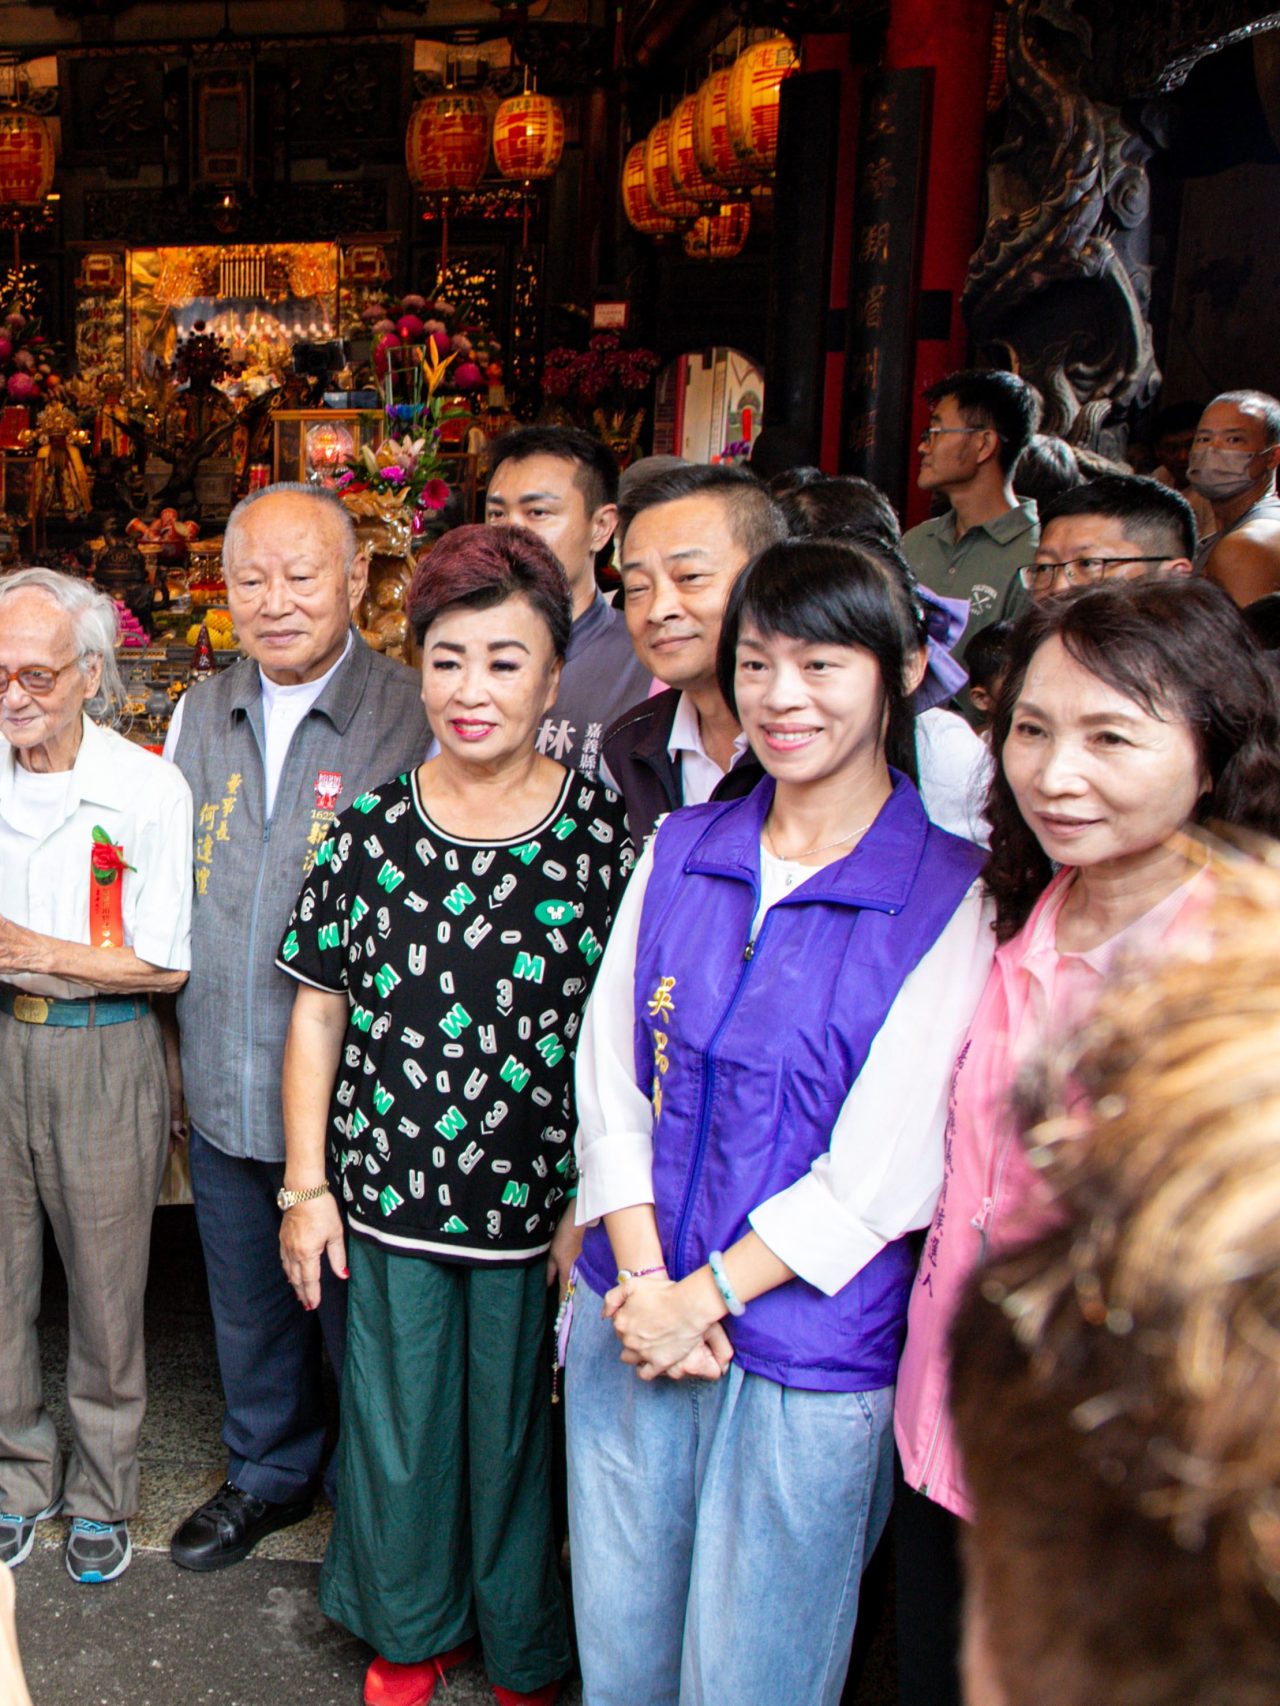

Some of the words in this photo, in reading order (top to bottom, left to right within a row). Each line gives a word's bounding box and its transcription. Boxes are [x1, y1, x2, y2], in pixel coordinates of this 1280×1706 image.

[216, 773, 242, 841] 董事長
[310, 809, 336, 822] 1622
